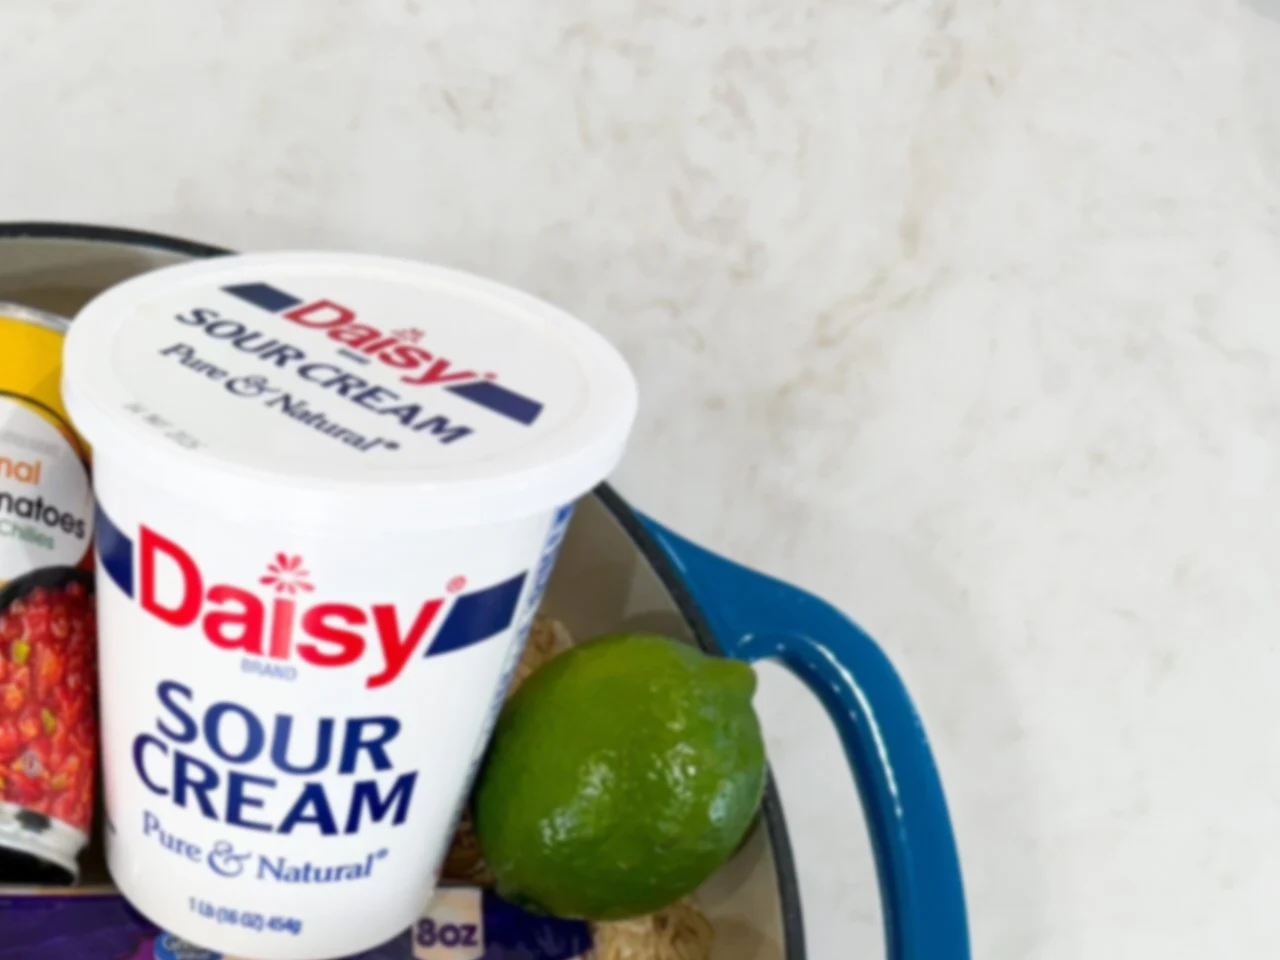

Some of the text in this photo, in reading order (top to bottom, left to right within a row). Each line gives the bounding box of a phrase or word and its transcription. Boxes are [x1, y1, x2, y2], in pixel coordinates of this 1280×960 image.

[160, 341, 228, 382] Pure
[223, 373, 280, 399] &
[175, 307, 475, 446] SOUR CREAM
[240, 658, 297, 682] BRAND
[155, 679, 402, 776] SOUR
[132, 733, 419, 837] CREAM
[142, 810, 202, 864] Pure
[207, 841, 251, 878] &
